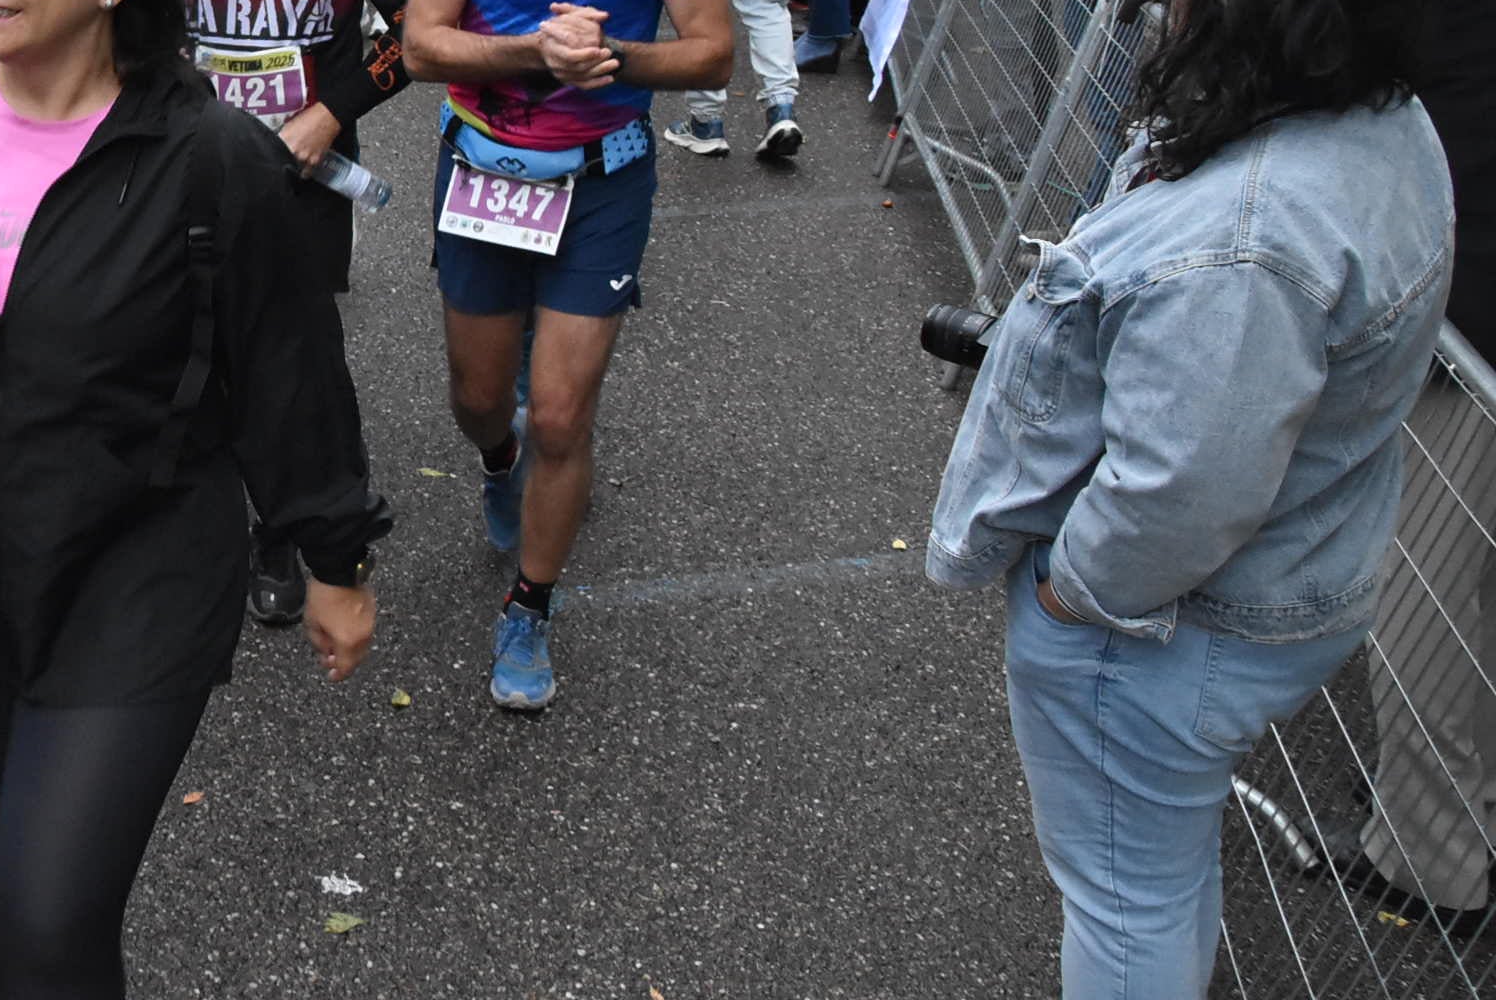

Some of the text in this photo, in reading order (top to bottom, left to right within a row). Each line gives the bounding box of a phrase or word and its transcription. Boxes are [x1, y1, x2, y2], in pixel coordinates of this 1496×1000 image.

[265, 53, 296, 70] 2025
[209, 74, 286, 109] 1421
[469, 174, 556, 222] 1347
